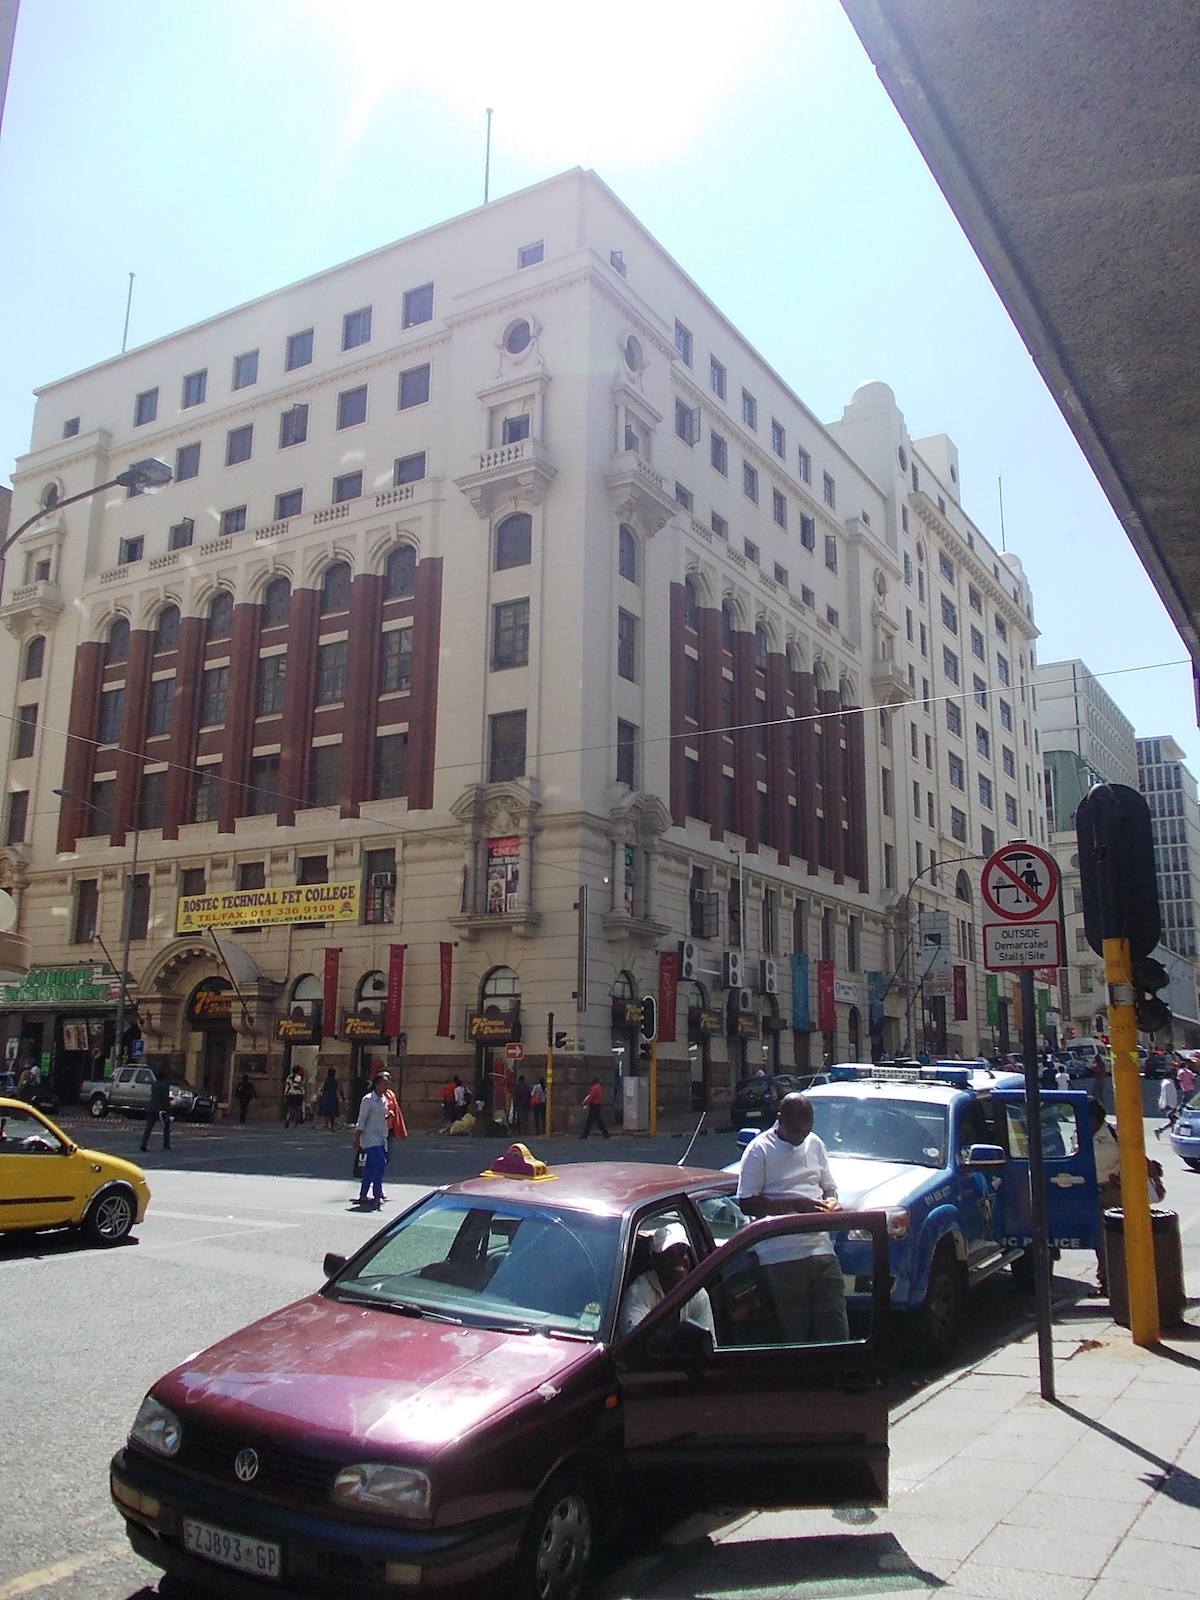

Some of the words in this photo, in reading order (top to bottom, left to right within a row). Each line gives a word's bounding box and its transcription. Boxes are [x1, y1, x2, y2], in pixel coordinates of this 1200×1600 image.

[183, 896, 219, 913] ROSTEC
[222, 892, 278, 910] TECHNICAL
[281, 889, 302, 904] FET
[305, 885, 355, 901] COLLEGE
[198, 911, 247, 922] TEL/FAX:
[251, 909, 272, 918] 011
[276, 906, 299, 916] 336
[304, 904, 335, 914] 9109
[197, 914, 335, 929] www.rostec.edu.za
[1001, 929, 1040, 939] OUTSIDE
[995, 940, 1048, 951] Demarcated
[999, 951, 1046, 961] Stalls/Site
[1023, 1236, 1081, 1248] PLICE
